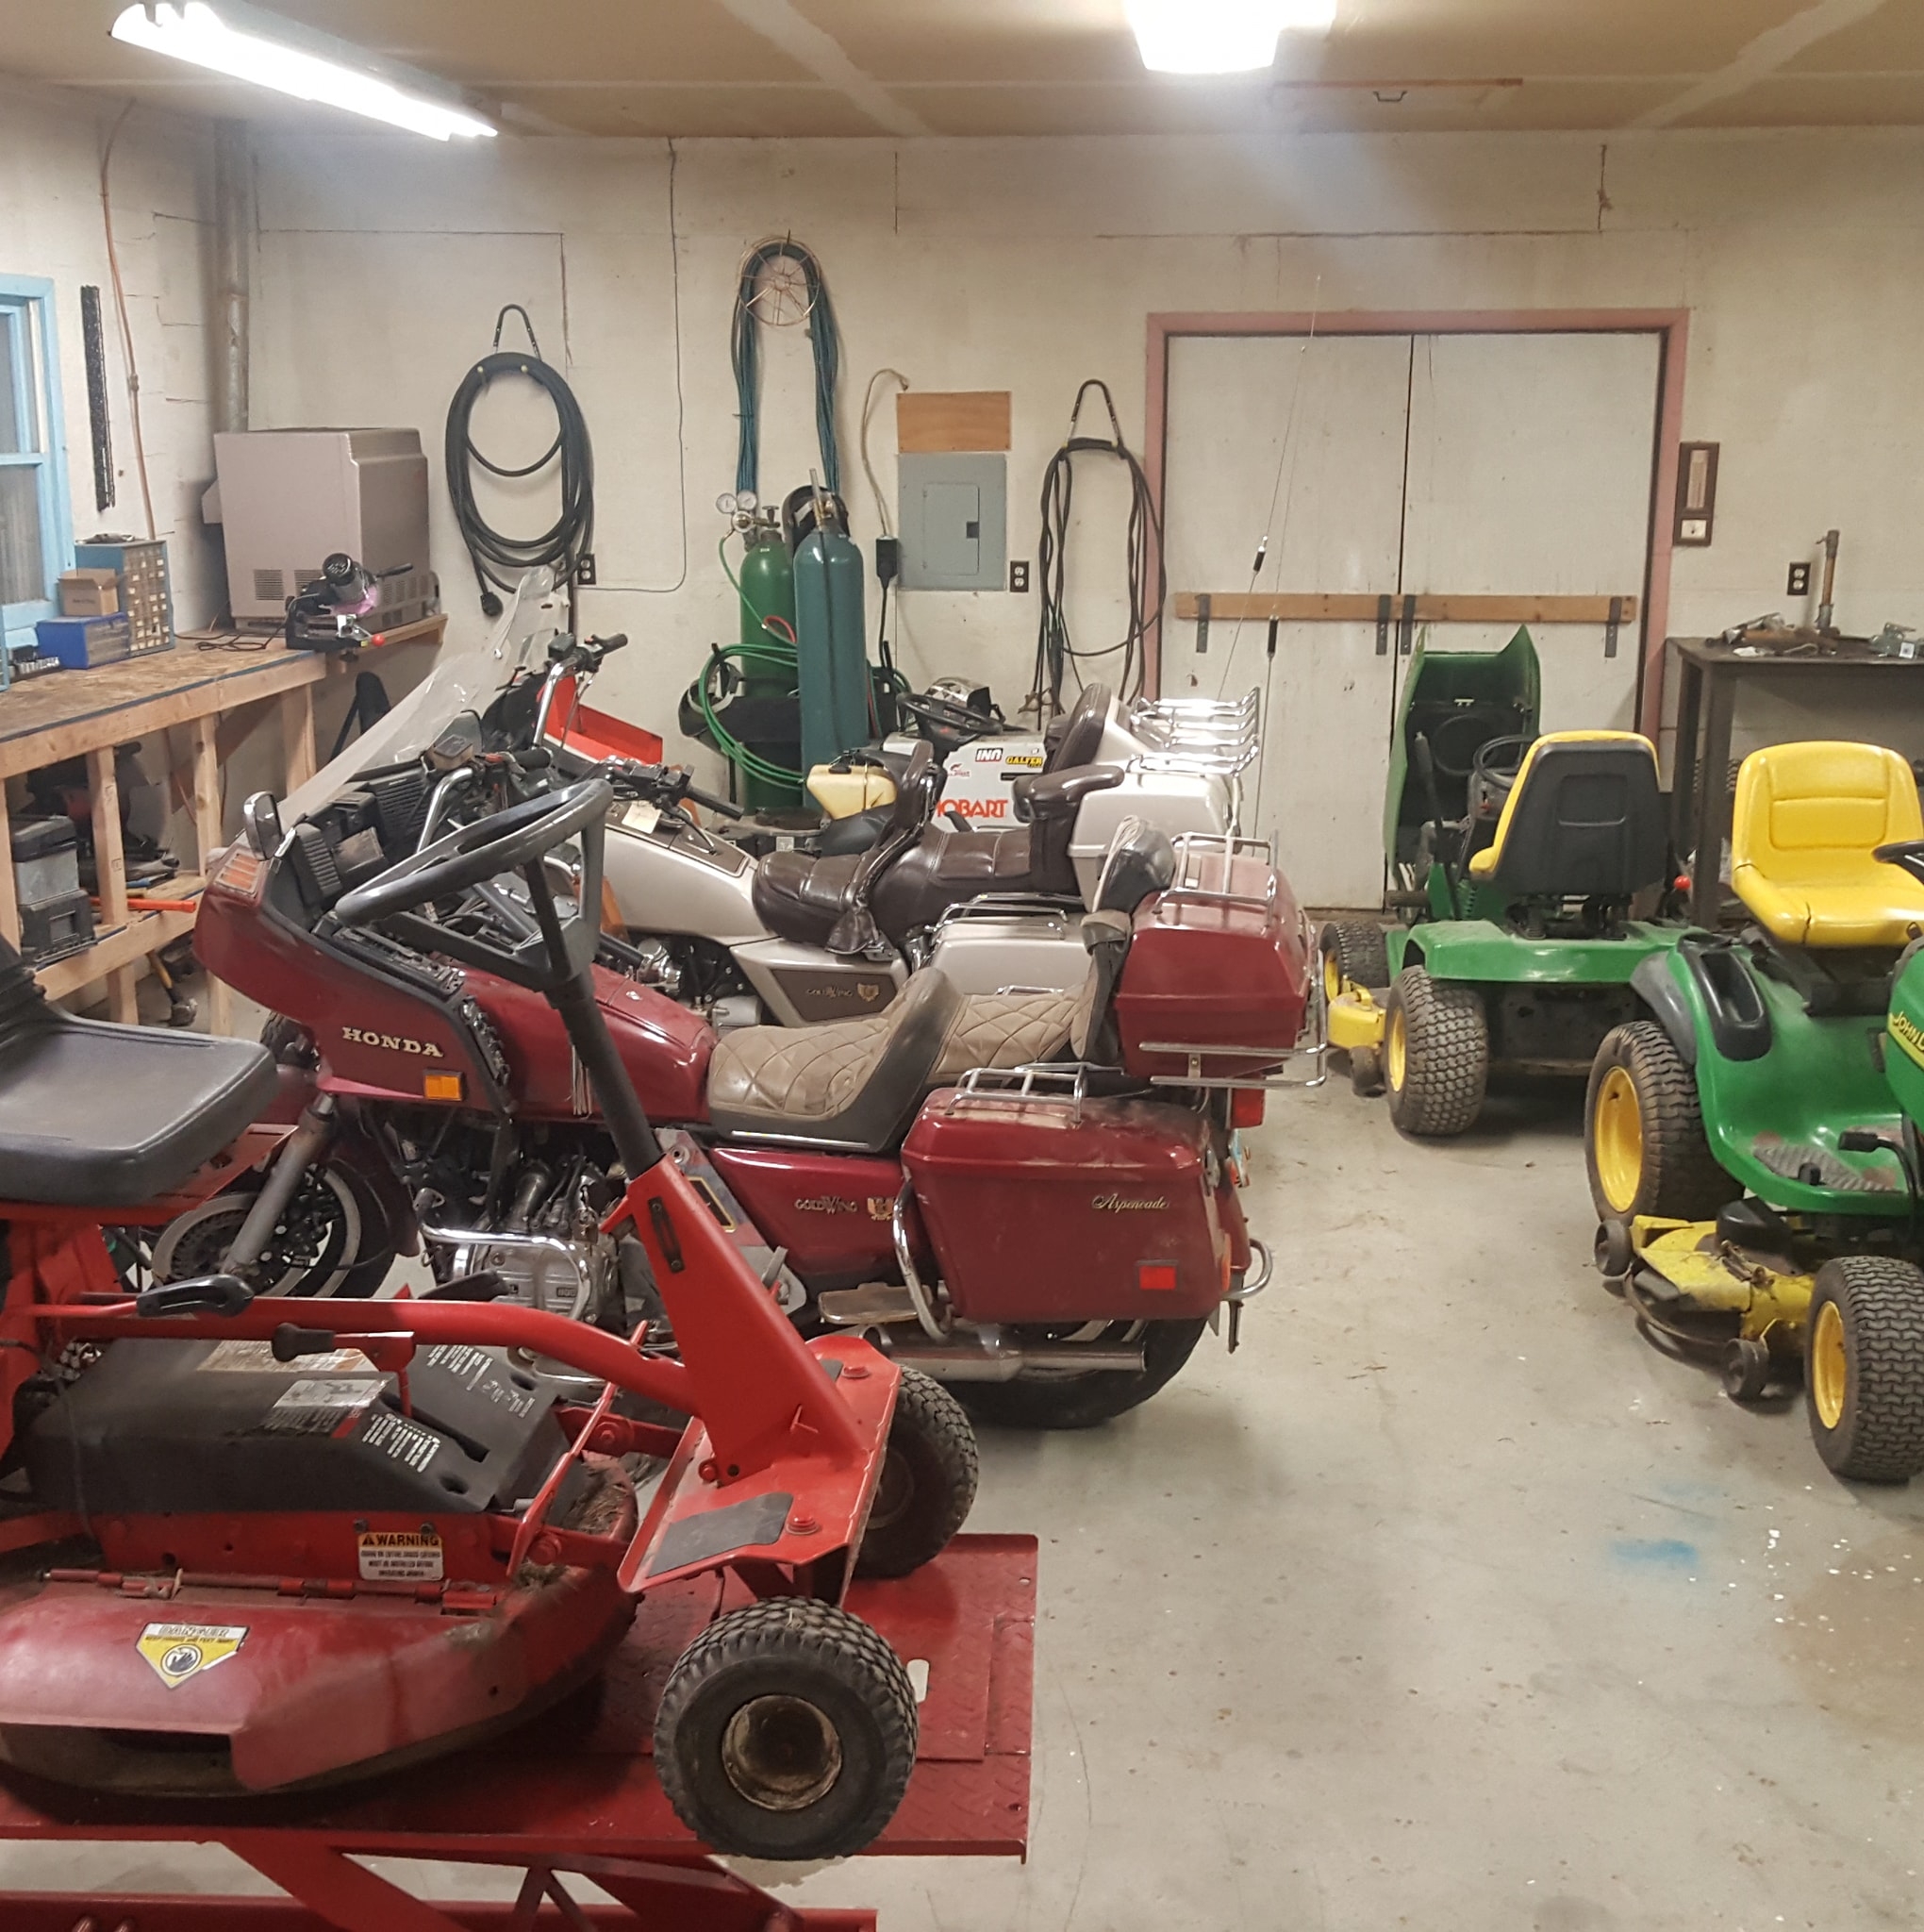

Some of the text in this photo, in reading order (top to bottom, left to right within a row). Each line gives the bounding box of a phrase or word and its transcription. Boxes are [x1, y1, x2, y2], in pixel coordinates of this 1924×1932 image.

[341, 1026, 444, 1058] HONDA
[376, 1534, 440, 1546] WARNING
[158, 1624, 229, 1638] DANGER
